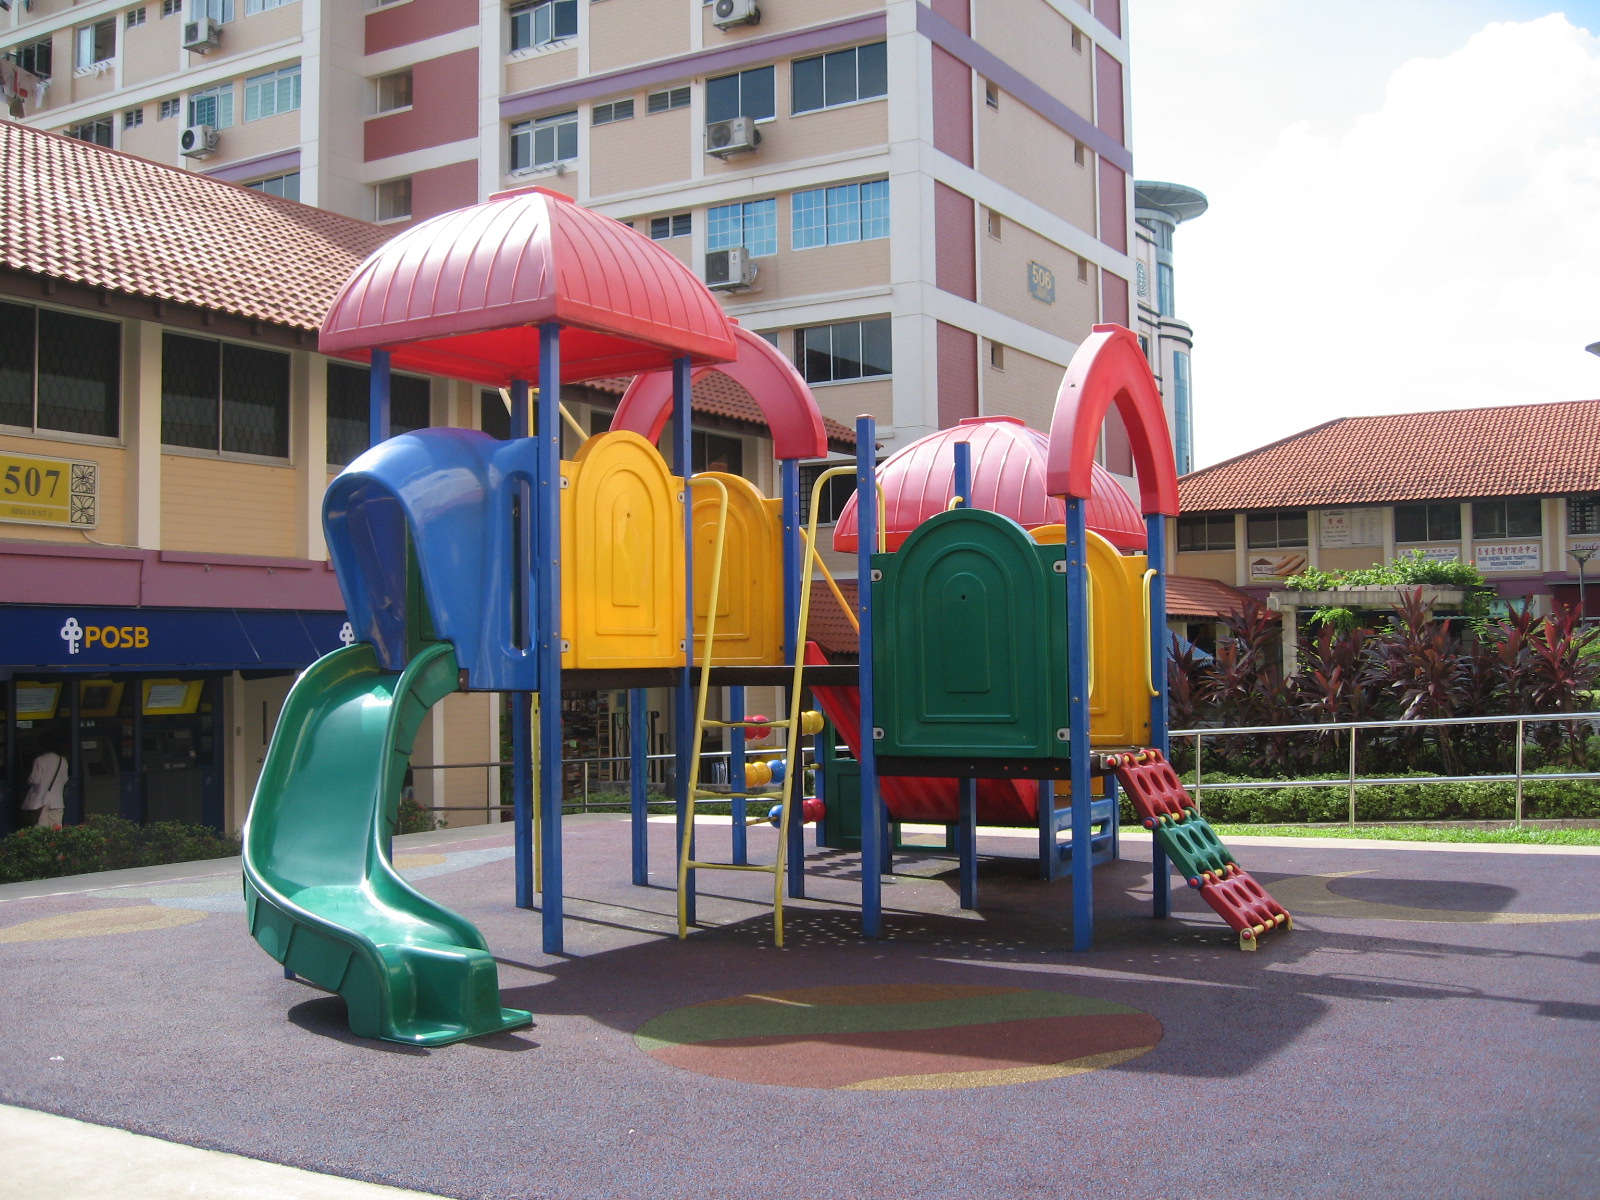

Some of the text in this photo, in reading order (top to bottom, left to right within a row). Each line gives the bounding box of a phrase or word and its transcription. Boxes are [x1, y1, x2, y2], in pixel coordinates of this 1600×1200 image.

[1032, 265, 1052, 289] 506
[4, 465, 61, 498] 507
[85, 625, 149, 648] POSB
